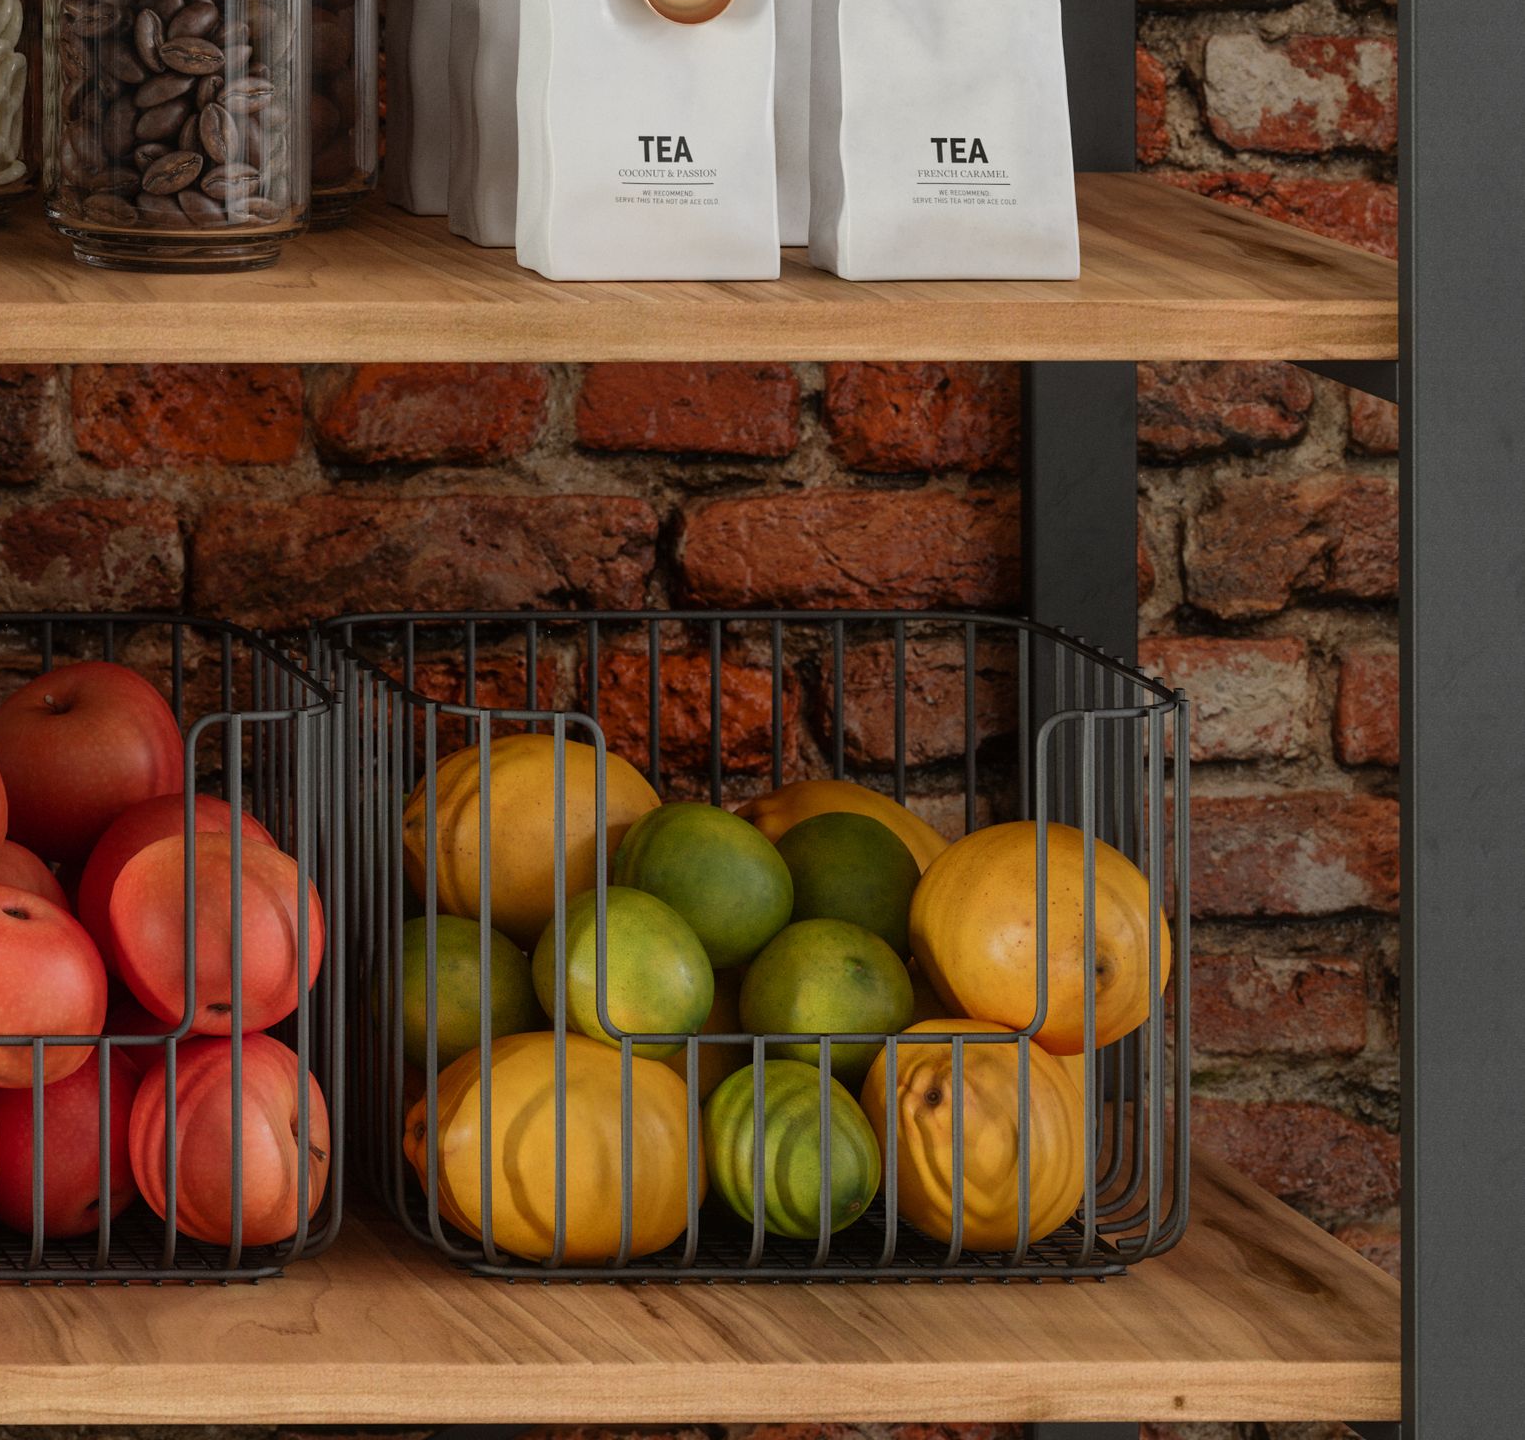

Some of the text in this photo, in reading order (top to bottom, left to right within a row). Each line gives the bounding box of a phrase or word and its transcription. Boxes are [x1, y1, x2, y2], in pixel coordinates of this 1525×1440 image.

[638, 136, 694, 163] TEA
[930, 137, 989, 164] TEA
[618, 169, 717, 178] COCONUT & PASSION
[917, 169, 1009, 179] FRENCH CARAMEL
